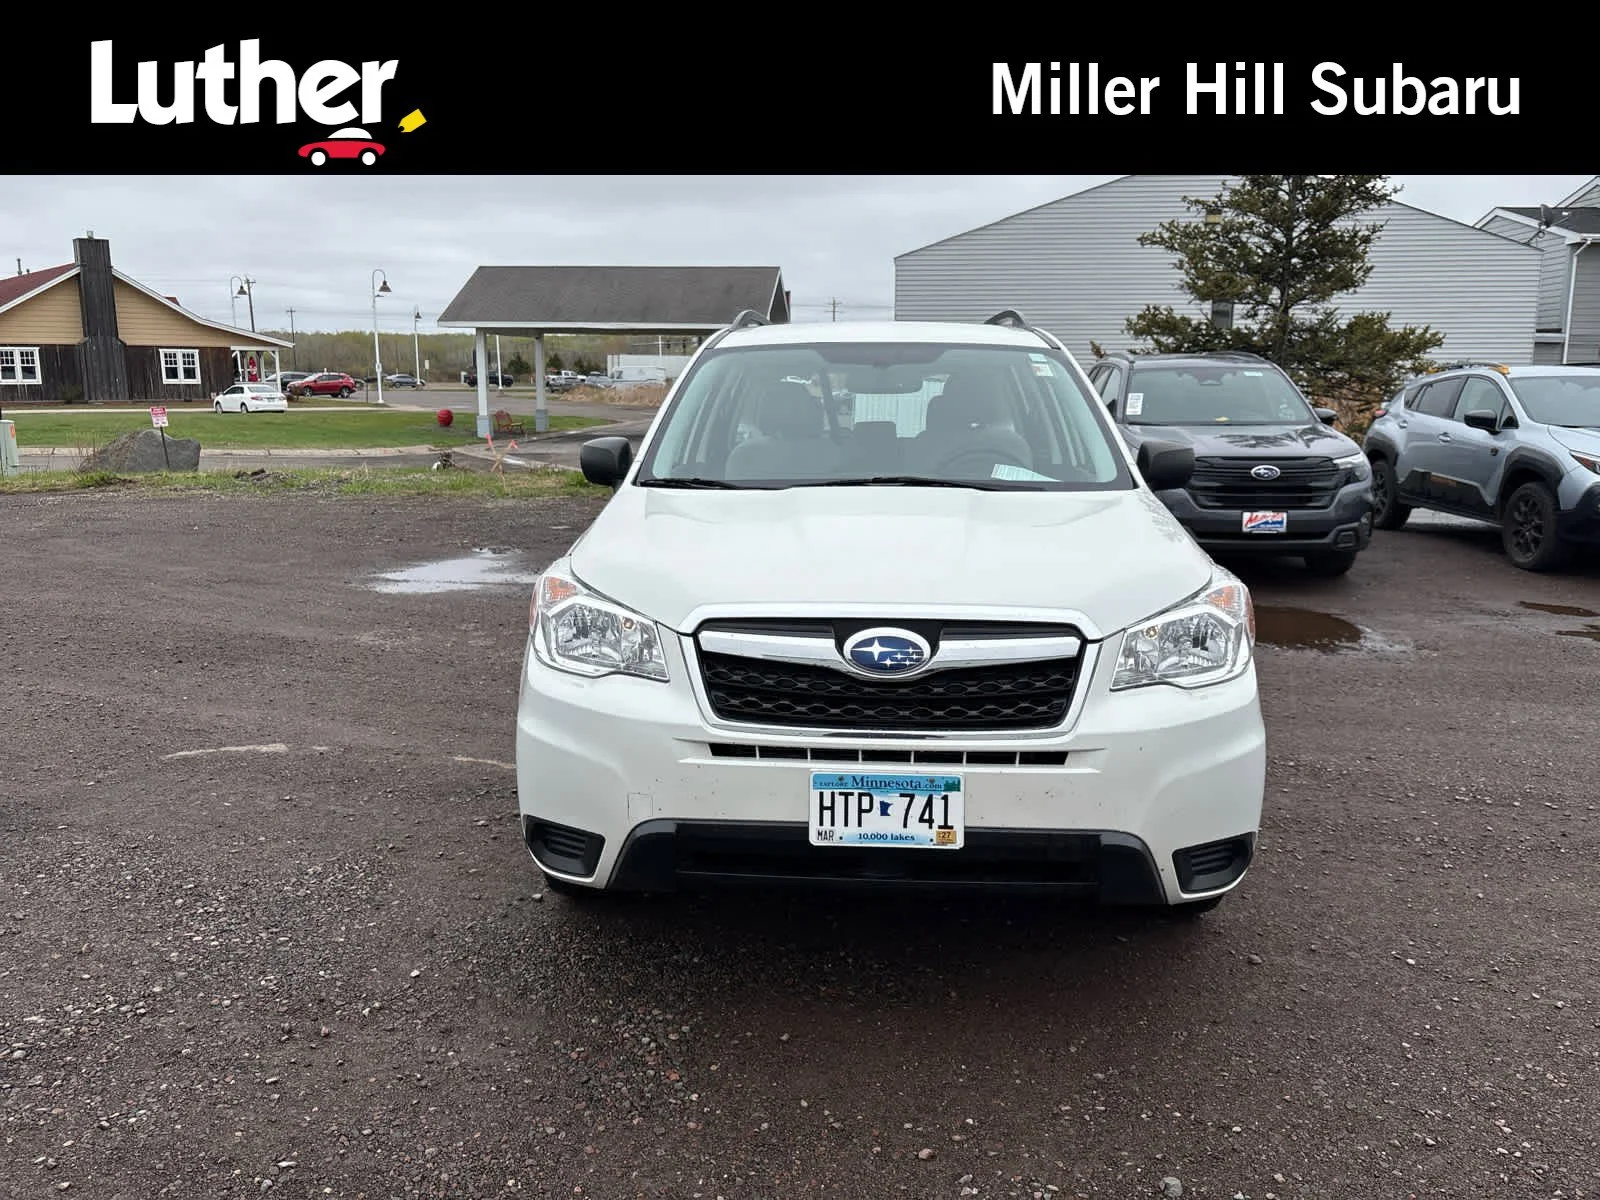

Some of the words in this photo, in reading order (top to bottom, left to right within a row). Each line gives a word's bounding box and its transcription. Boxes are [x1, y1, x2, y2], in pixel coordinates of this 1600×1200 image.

[819, 791, 874, 827] HTP
[899, 793, 954, 830] 741
[817, 829, 835, 842] MAR
[890, 833, 915, 841] lakes
[941, 831, 952, 839] 27
